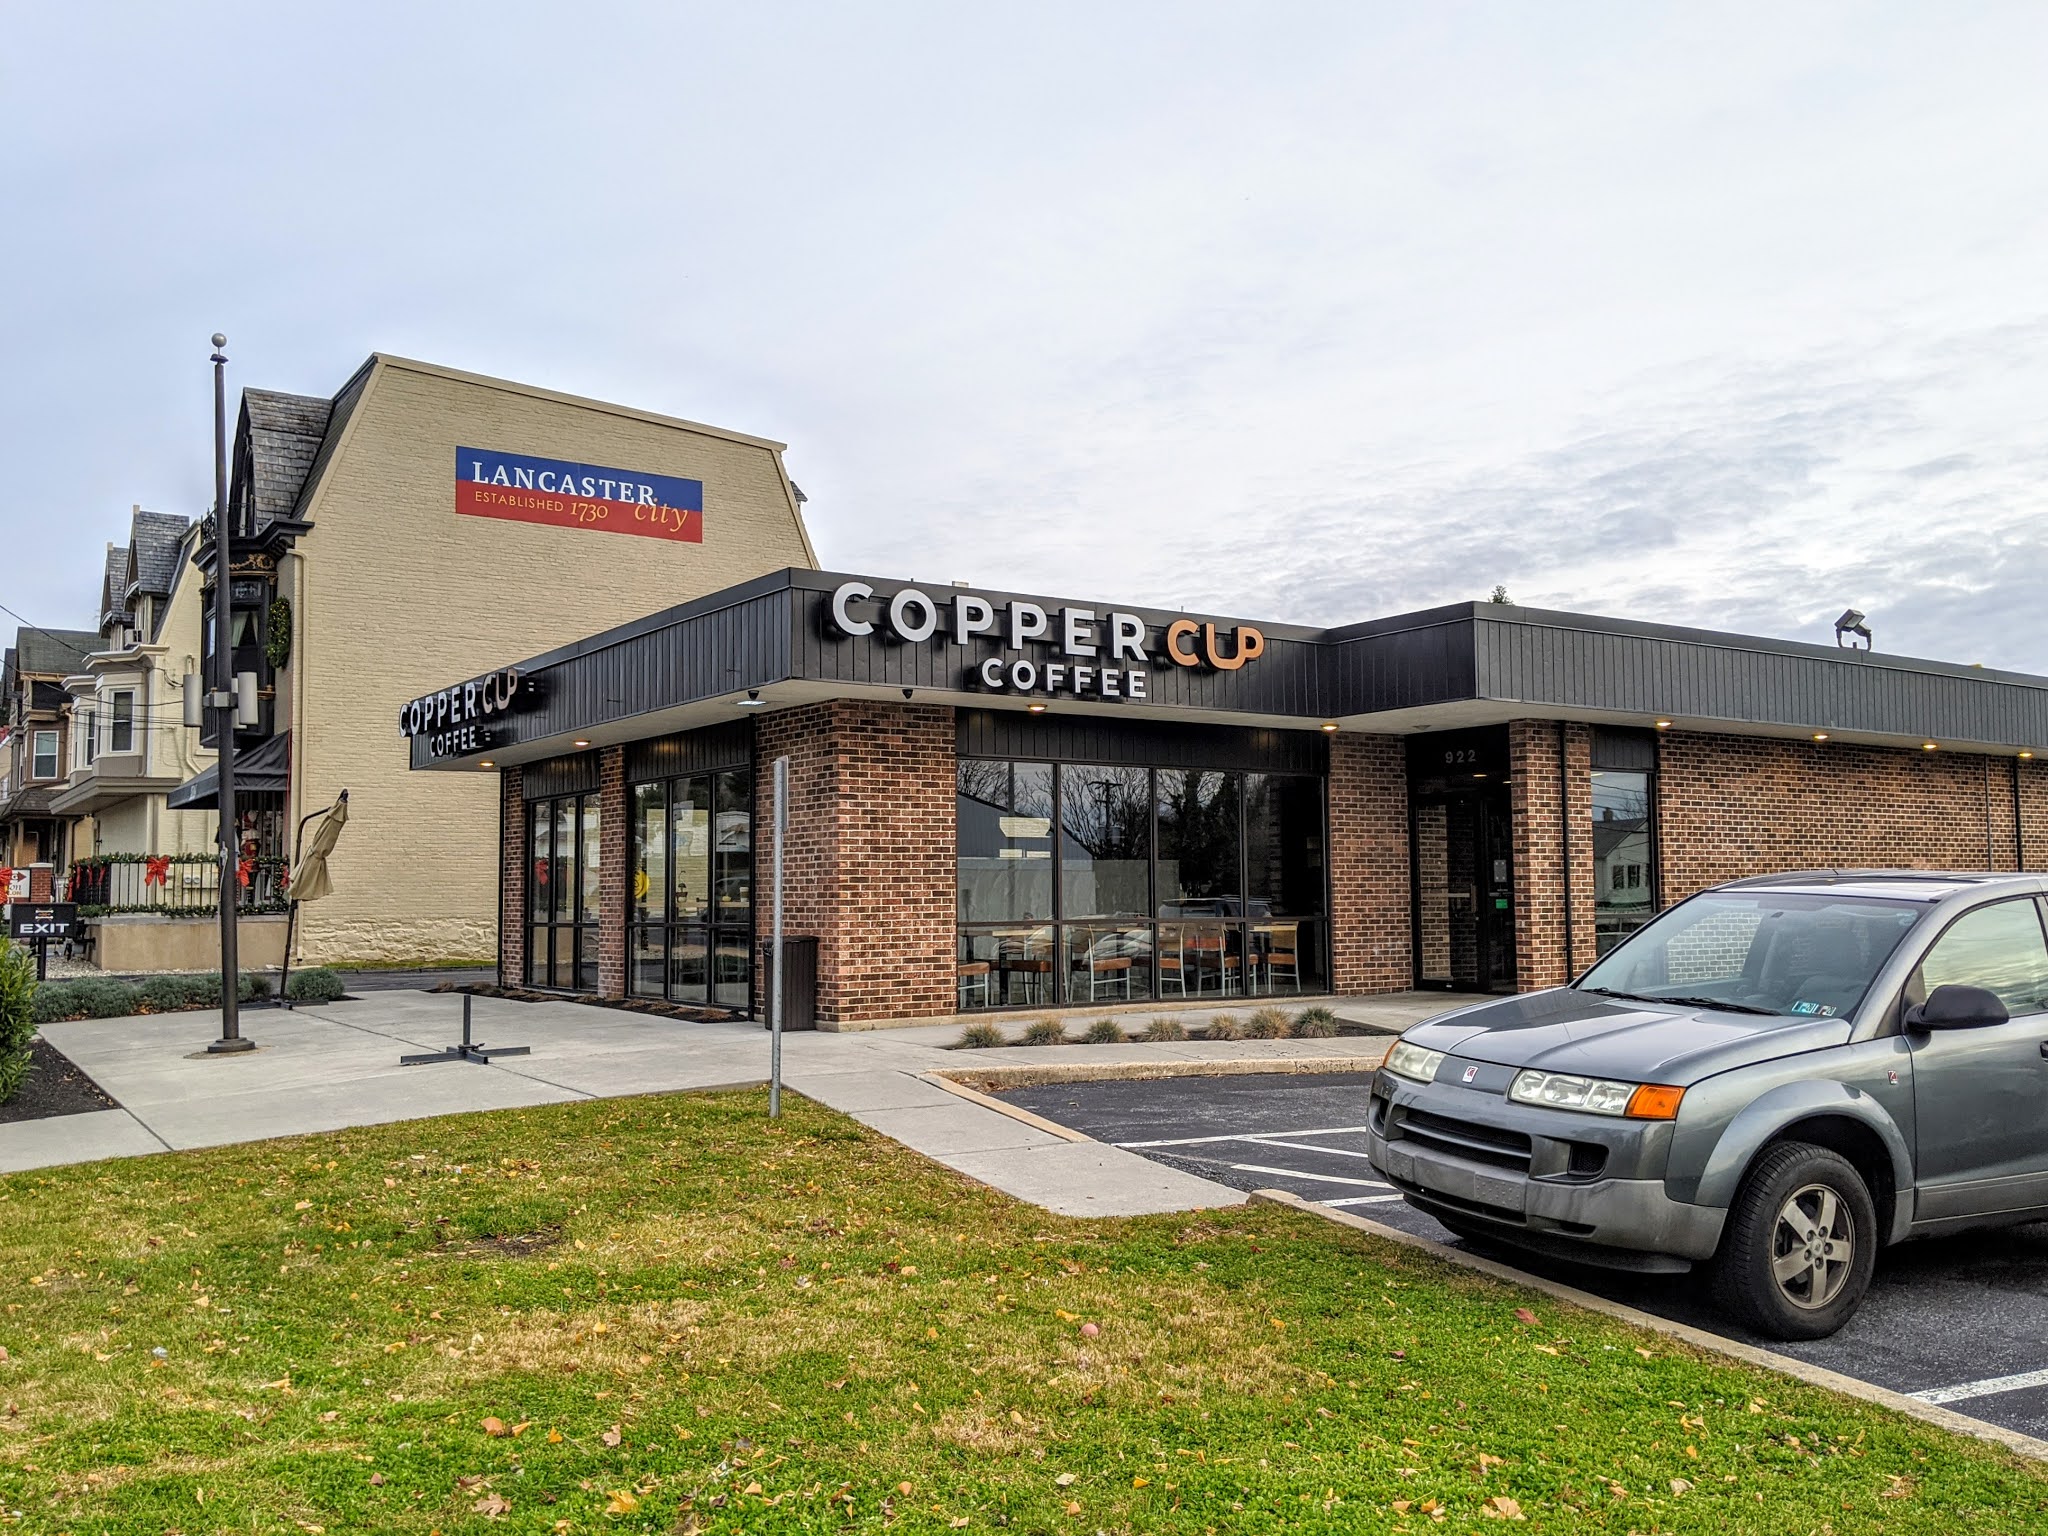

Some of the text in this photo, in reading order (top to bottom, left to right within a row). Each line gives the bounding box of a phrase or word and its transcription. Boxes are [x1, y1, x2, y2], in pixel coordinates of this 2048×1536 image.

[472, 461, 688, 532] LANCASTER city
[475, 490, 608, 522] ESTABLISHED 1730
[831, 581, 1265, 671] COPPER CUP
[980, 657, 1147, 698] COFFEE
[399, 667, 518, 738] COPPER CUP
[430, 725, 477, 758] COFFEE
[1445, 749, 1477, 764] 922
[19, 923, 70, 934] EXIT
